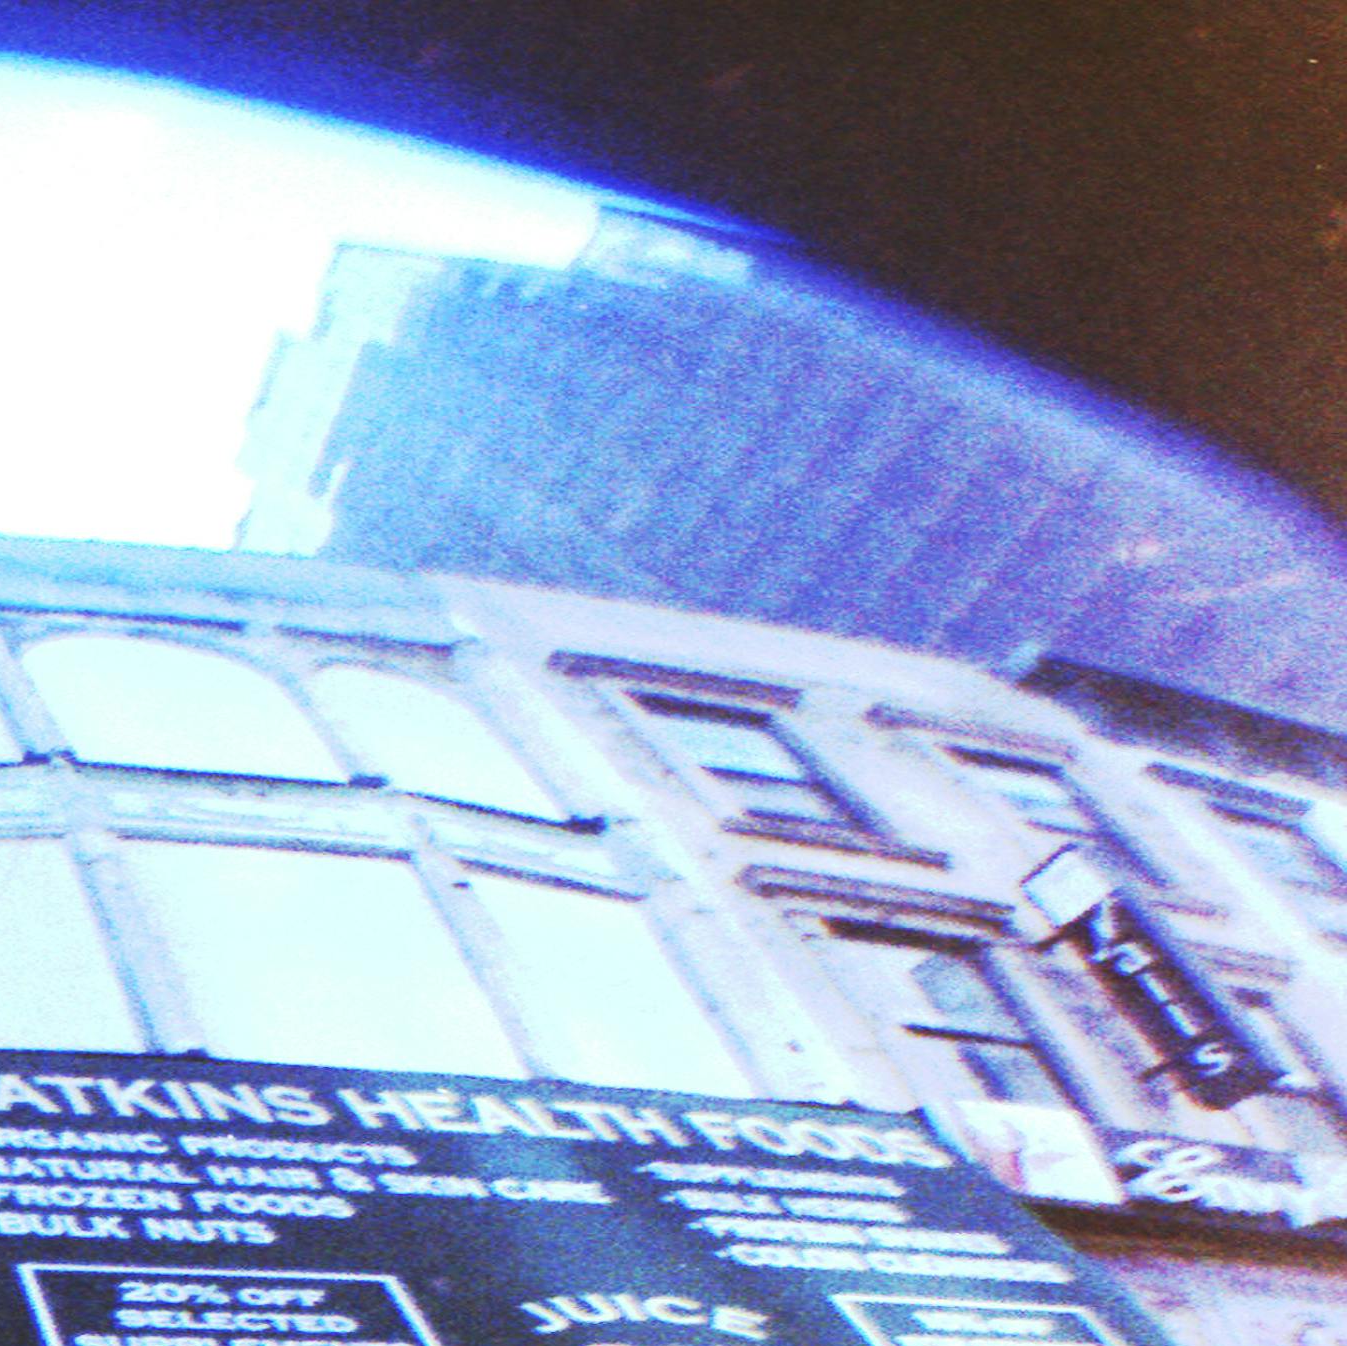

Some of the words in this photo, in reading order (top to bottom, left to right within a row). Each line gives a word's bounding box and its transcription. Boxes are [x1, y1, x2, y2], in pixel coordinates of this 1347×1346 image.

[338, 1087, 690, 1148] HEALTH
[685, 1109, 957, 1169] FOODS
[179, 1135, 418, 1167] PRODUCTS
[205, 1163, 322, 1190] HAIR
[328, 1167, 376, 1193] &
[376, 1171, 491, 1199] SKIN
[191, 1190, 356, 1219] FOODS
[140, 1216, 277, 1245] NUTS
[118, 1281, 231, 1304] 20%
[237, 1287, 326, 1307] OFF
[113, 1308, 361, 1333] SELECTED
[517, 1293, 773, 1342] JUICE
